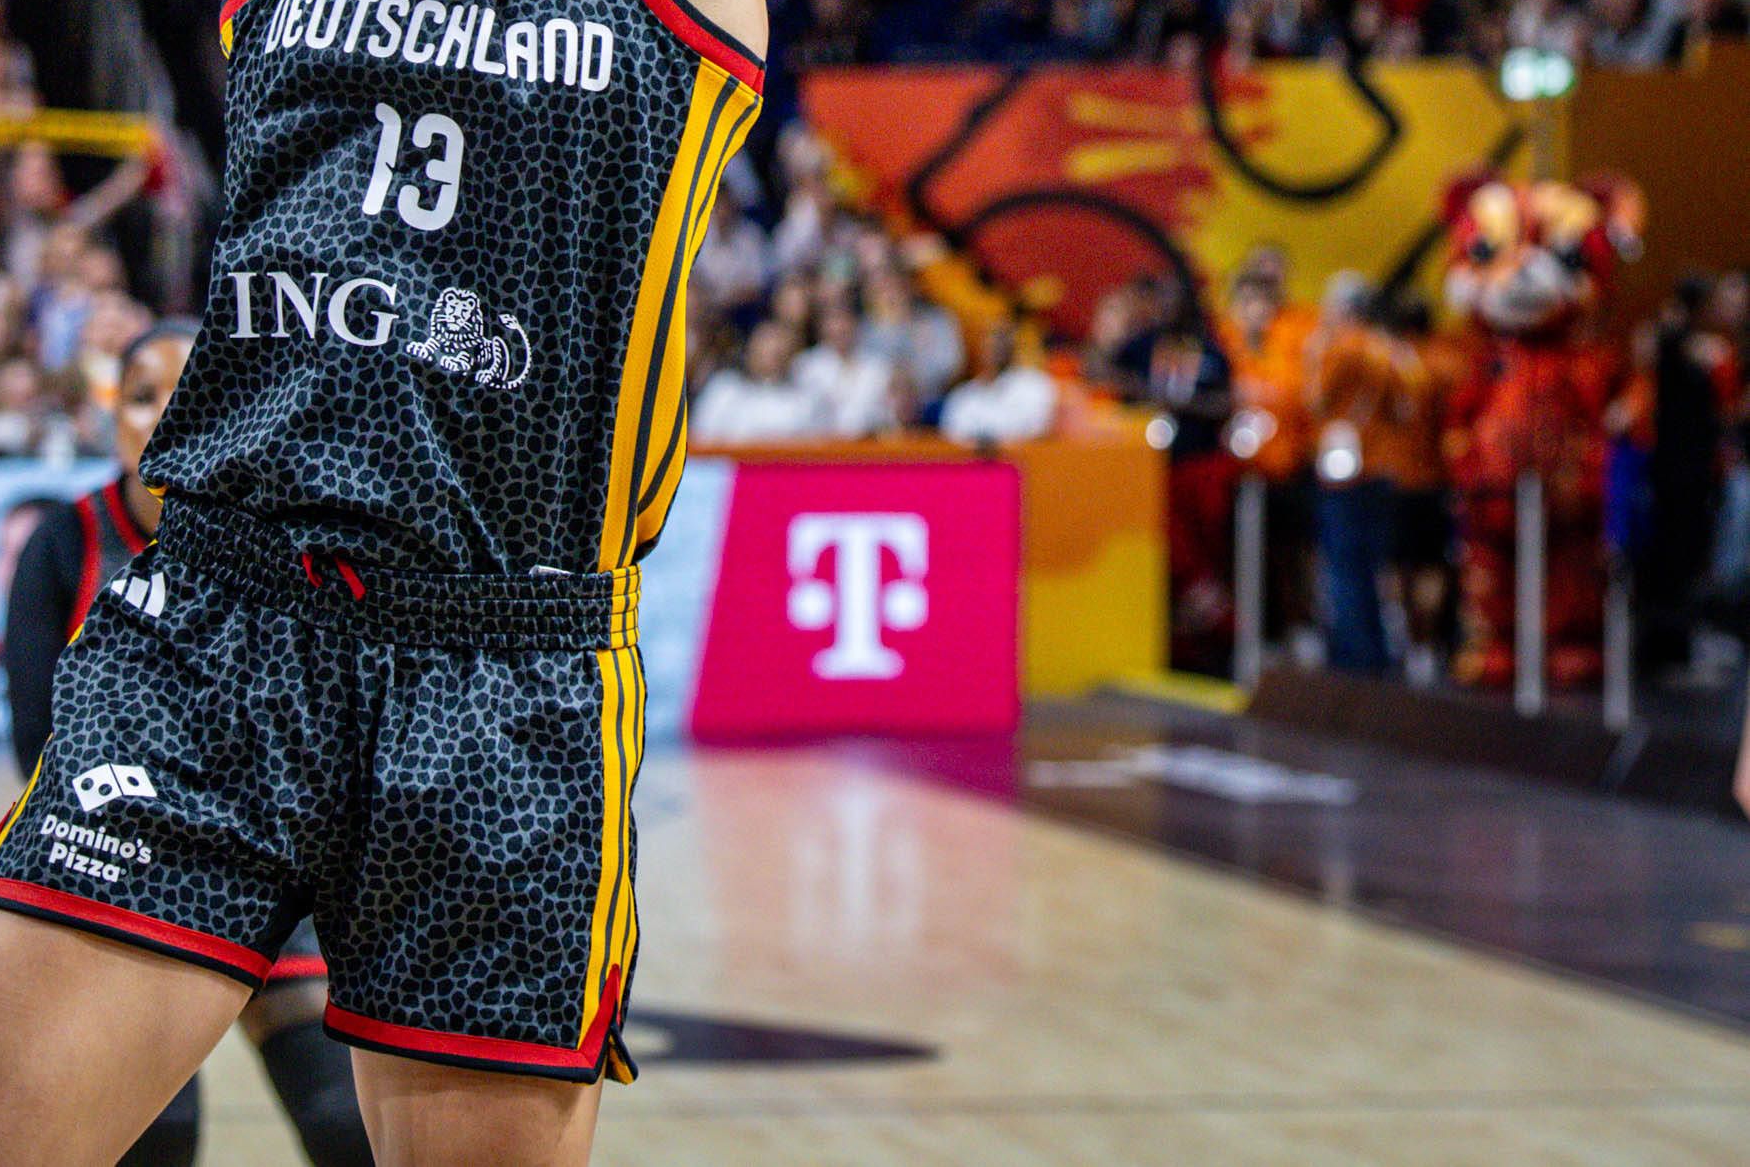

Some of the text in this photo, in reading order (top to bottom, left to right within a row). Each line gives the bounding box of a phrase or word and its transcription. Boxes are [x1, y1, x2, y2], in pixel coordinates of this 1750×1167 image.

[361, 102, 466, 231] 13
[227, 271, 400, 347] ING
[40, 814, 153, 865] Domino's
[48, 842, 122, 883] Pizza
